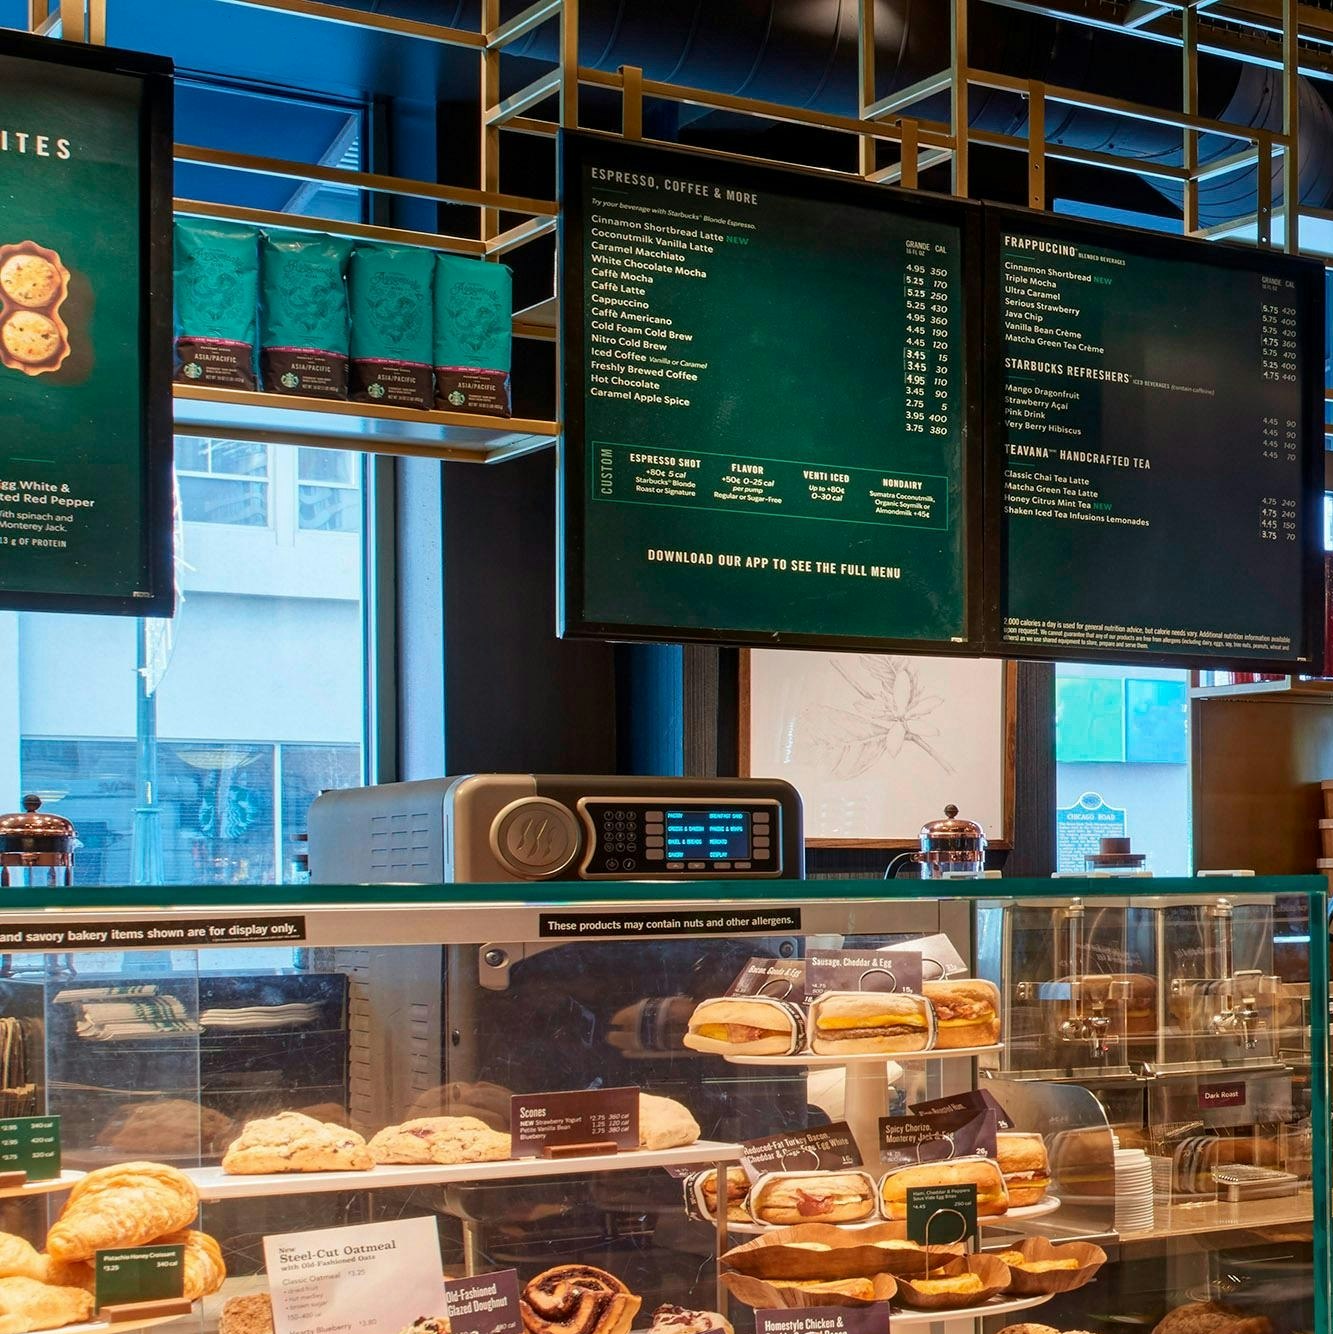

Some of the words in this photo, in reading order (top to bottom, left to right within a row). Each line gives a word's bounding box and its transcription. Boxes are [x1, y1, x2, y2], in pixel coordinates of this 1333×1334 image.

[591, 166, 659, 190] ESPRESSO,
[663, 178, 709, 197] COFFEE
[713, 186, 721, 199] &
[725, 188, 758, 205] MORE
[590, 214, 642, 229] Cinnamon
[643, 221, 698, 238] Shortbread
[699, 230, 724, 242] Latte
[590, 240, 633, 254] Caramel
[634, 246, 685, 262] Macchiato
[590, 253, 622, 266] White
[622, 258, 673, 273] Chocolate
[674, 265, 707, 278] Mocha
[590, 266, 618, 279] Caffè
[619, 270, 653, 283] Mocha
[905, 263, 925, 274] 4.95
[929, 266, 948, 277] 350
[1003, 260, 1046, 275] Cinnamon
[1046, 267, 1092, 282] Shortbread
[590, 293, 649, 309] Cappuccino
[590, 306, 618, 318] Caffè
[619, 310, 672, 326] Americano
[590, 320, 614, 331] Cold
[615, 323, 642, 335] Foam
[643, 326, 667, 338] Cold
[668, 329, 693, 341] Brew
[590, 333, 617, 345] Nitro
[617, 336, 641, 348] Cold
[642, 339, 667, 351] Brew
[194, 352, 237, 365] ASIA/PACIFIC
[1004, 356, 1063, 375] STARBUCKS
[1066, 365, 1129, 384] REFRESHERS
[590, 373, 609, 384] Hot
[610, 375, 660, 390] Chocolate
[589, 386, 631, 400] Caramel
[632, 391, 662, 403] Apple
[663, 394, 690, 406] Spice
[1059, 449, 1129, 467] HANDCRAFTED
[1132, 457, 1150, 469] TEA
[0, 480, 17, 491] gg
[19, 480, 58, 492] White
[60, 483, 71, 494] &
[23, 493, 48, 504] Red
[50, 495, 95, 508] Pepper
[1003, 505, 1033, 515] Shaken
[1034, 508, 1052, 517] Iced
[1053, 509, 1068, 518] Tea
[1068, 511, 1105, 522] Infusions
[1105, 514, 1149, 526] Lemonades
[647, 548, 713, 565] DOWNLOAD
[717, 553, 741, 567] OUR
[744, 555, 769, 569] APP
[771, 557, 787, 570] TO
[790, 559, 812, 572] SEE
[814, 560, 836, 574] THE
[840, 562, 867, 576] FULL
[870, 565, 900, 579] MENU
[0, 930, 22, 942] and
[25, 932, 64, 943] savory
[67, 929, 108, 942] bakery
[110, 928, 144, 939] items
[146, 927, 184, 939] shown
[186, 927, 206, 937] are
[208, 925, 226, 936] for
[227, 923, 268, 936] display
[269, 922, 297, 935] only.
[546, 920, 577, 930] These
[578, 920, 621, 932] products
[623, 920, 644, 931] may
[645, 918, 681, 929] contain
[683, 918, 704, 928] nuts
[705, 917, 724, 927] and
[725, 916, 750, 926] other
[750, 915, 794, 927] allergens.
[811, 956, 842, 969] Sausage,
[842, 956, 871, 968] Cheddar
[871, 957, 878, 968] &
[878, 957, 893, 970] Egg
[1204, 1091, 1220, 1100] Dark
[1220, 1090, 1239, 1099] Roast
[519, 1106, 547, 1119] Scones
[279, 1248, 339, 1264] Steel-Cut
[343, 1239, 397, 1256] Oatmeal
[446, 1282, 498, 1305] Old-Fashioned
[448, 1299, 473, 1317] Glazed
[473, 1295, 508, 1314] Doughnut
[764, 1320, 804, 1332] Homestyle
[804, 1318, 835, 1330] Chicken
[836, 1316, 844, 1328] &
